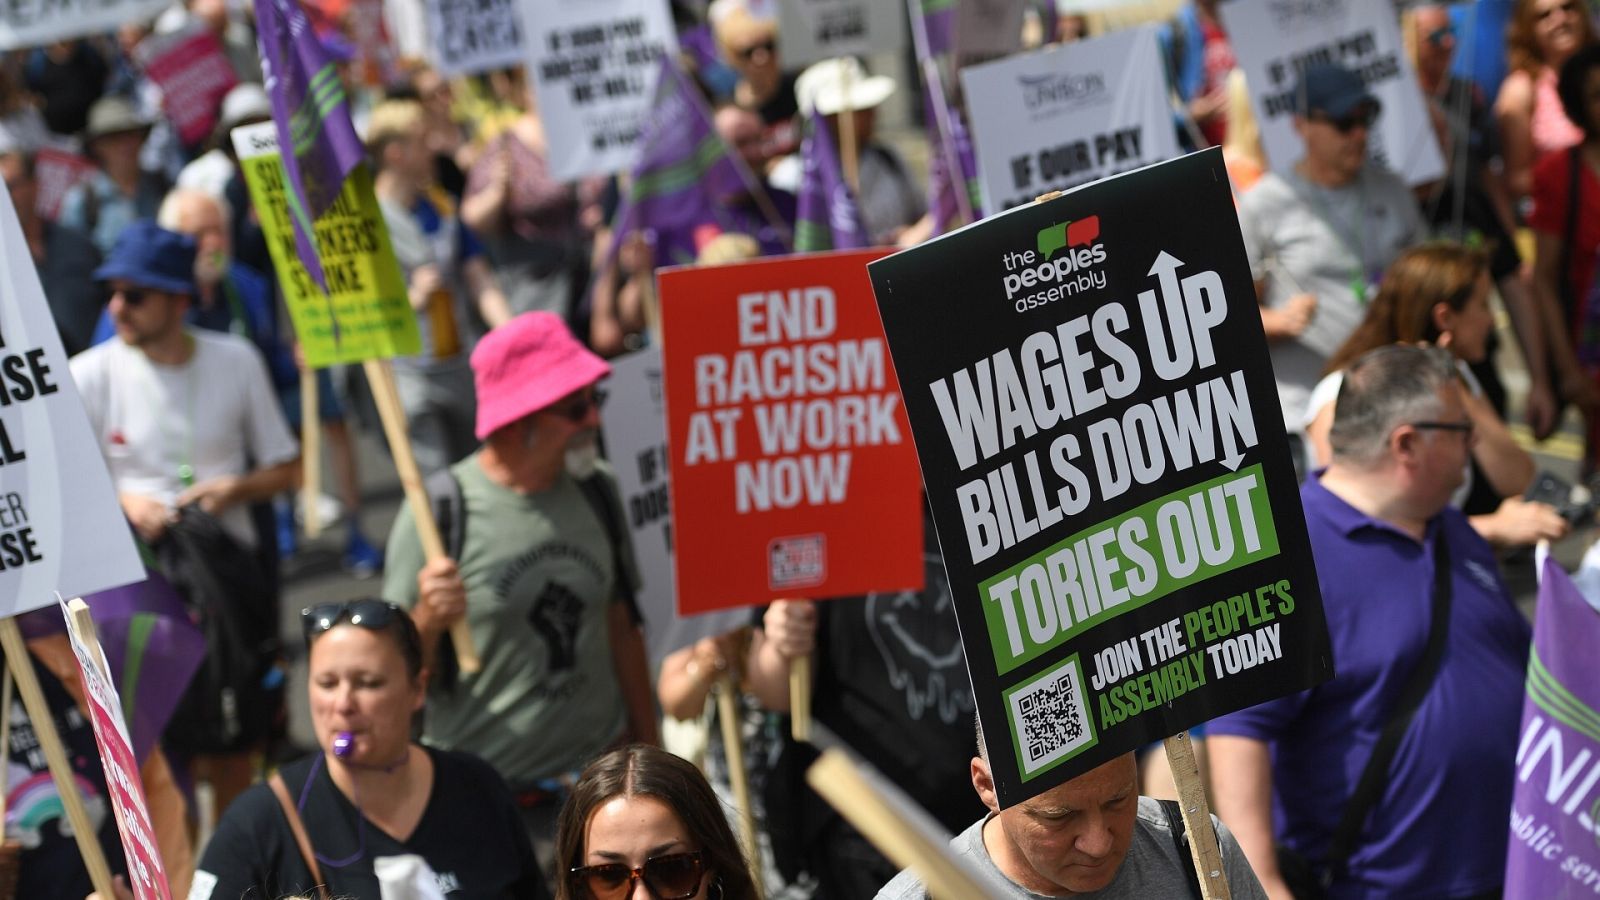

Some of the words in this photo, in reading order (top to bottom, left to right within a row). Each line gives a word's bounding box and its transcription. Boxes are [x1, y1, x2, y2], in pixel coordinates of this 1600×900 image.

[1010, 154, 1034, 190] IF
[1039, 138, 1091, 180] OUR
[1095, 125, 1144, 166] PAY
[290, 262, 364, 300] SIKE
[1003, 247, 1036, 269] the
[1003, 242, 1107, 299] peoples
[1015, 269, 1107, 313] assembly
[737, 286, 837, 347] END
[694, 338, 885, 407] RACISM
[929, 302, 1141, 471] WAGES
[1137, 269, 1228, 381] UP
[684, 408, 742, 465] AT
[753, 393, 902, 456] WORK
[734, 453, 851, 514] NOW
[956, 433, 1091, 565] BILLS
[1087, 370, 1259, 501] DOWN
[988, 516, 1159, 657] TORIES
[1156, 474, 1263, 579] OUT
[1091, 634, 1143, 691] JOIN
[1140, 618, 1185, 668] THE
[1184, 579, 1295, 648] PEOPLE'S
[1100, 648, 1207, 730] ASSEMBLY
[1206, 623, 1283, 680] TODAY
